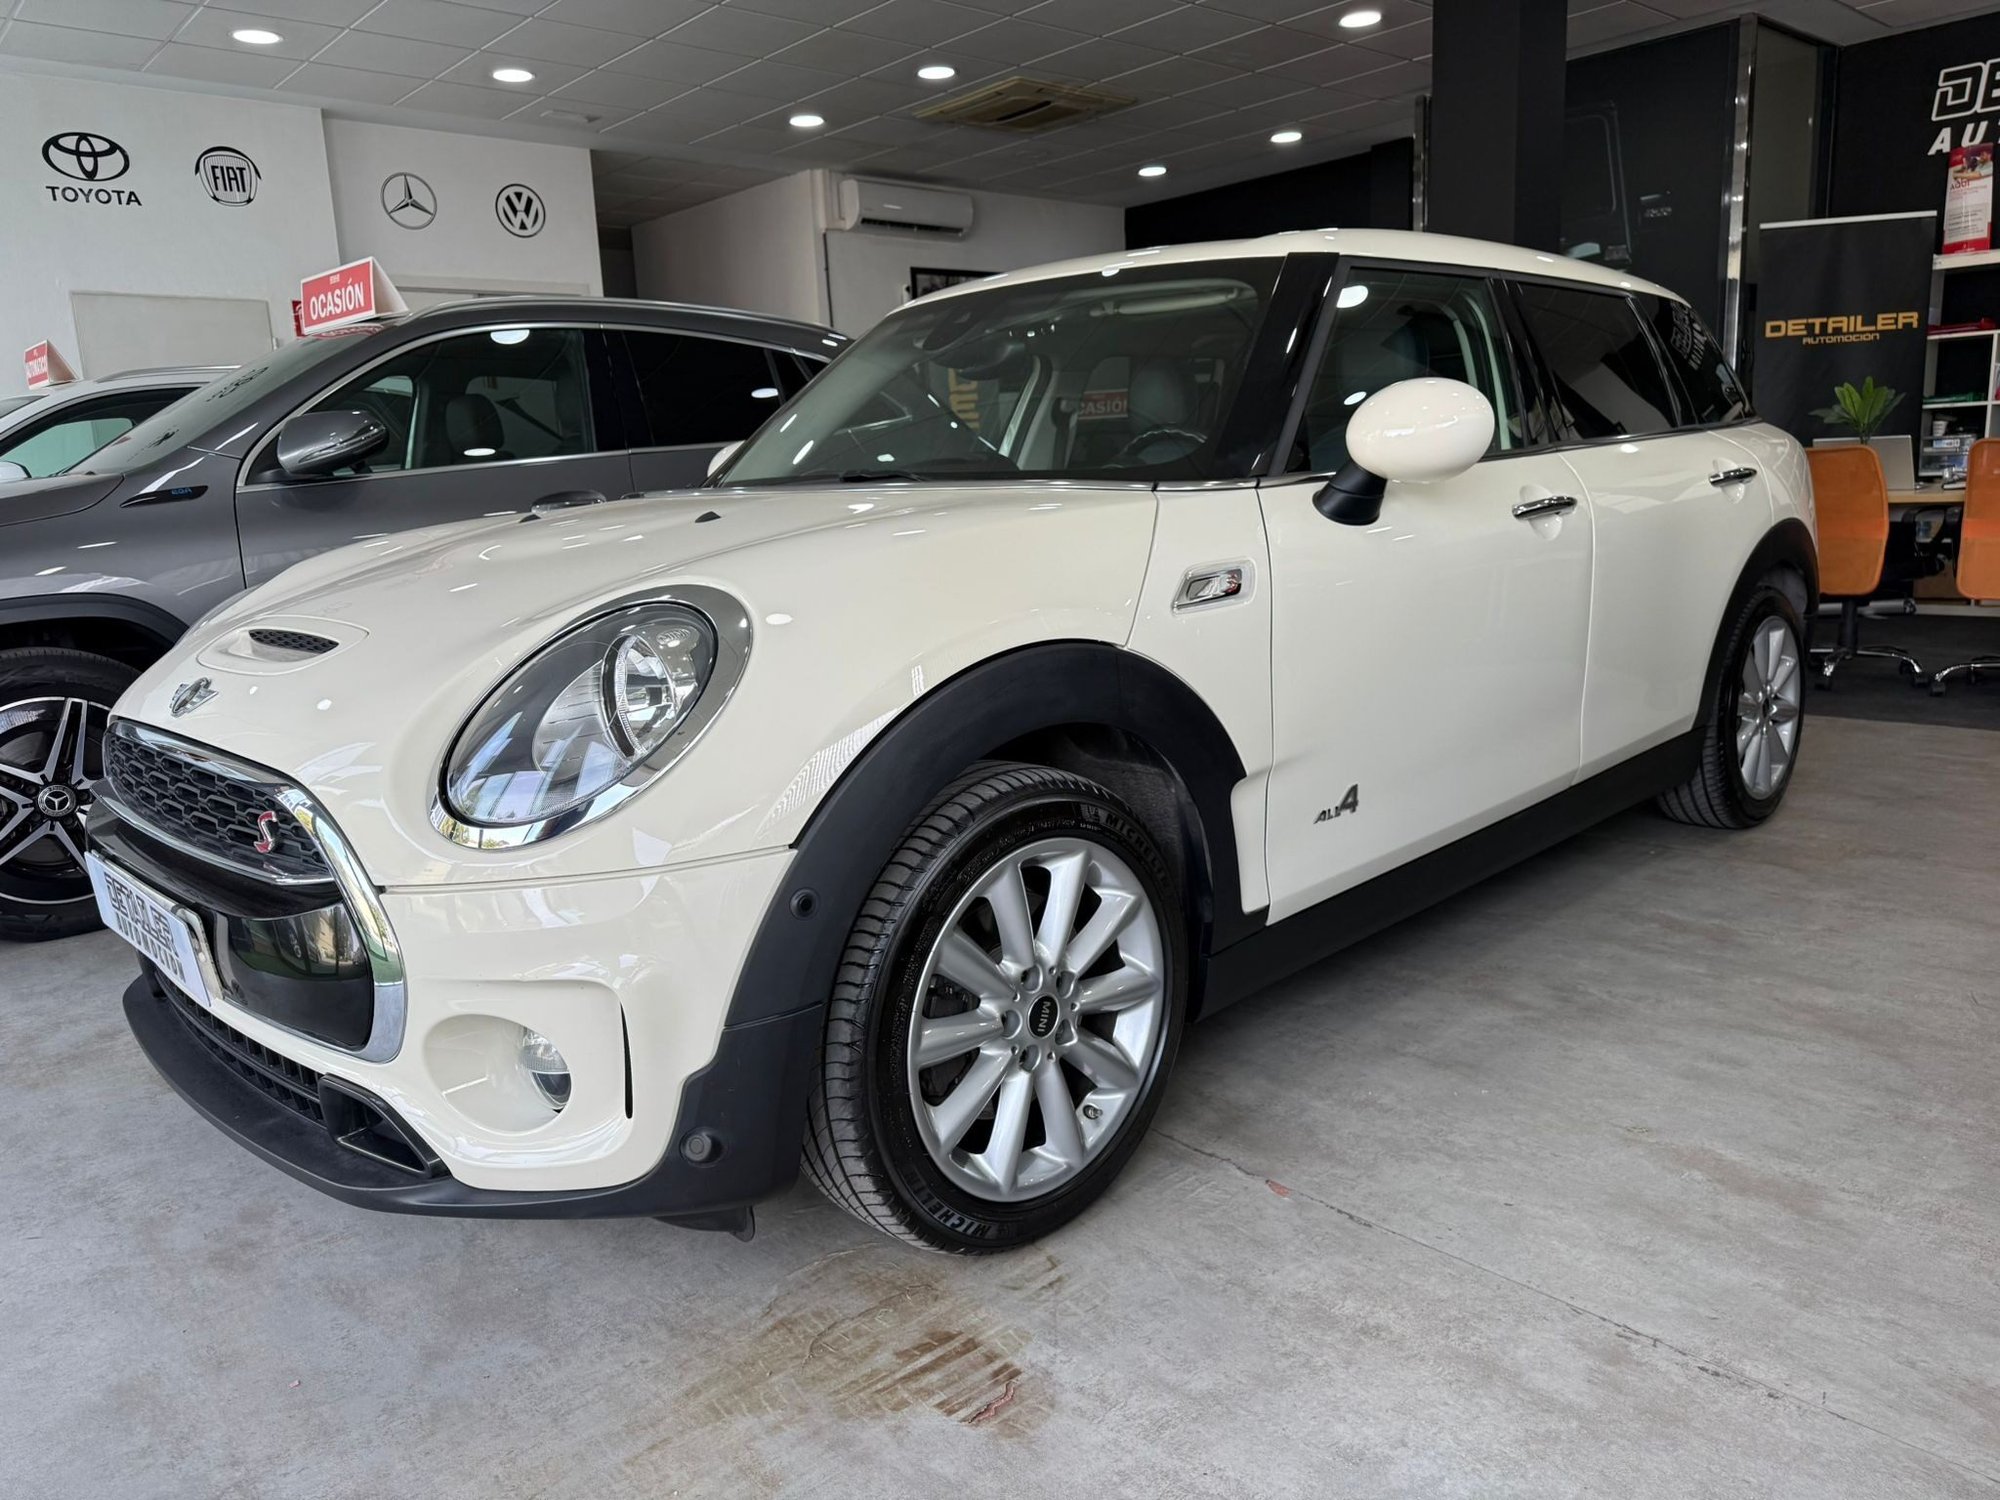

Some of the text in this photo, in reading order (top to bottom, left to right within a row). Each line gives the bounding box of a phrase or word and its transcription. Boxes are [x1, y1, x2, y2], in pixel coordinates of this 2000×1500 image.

[1927, 119, 2000, 156] AU
[210, 165, 247, 193] FIAT
[45, 185, 143, 207] TOYOTA
[498, 186, 543, 235] VW
[309, 277, 365, 320] OCASIÓN
[1765, 311, 1919, 338] DETAILER
[1037, 1001, 1051, 1032] MINI
